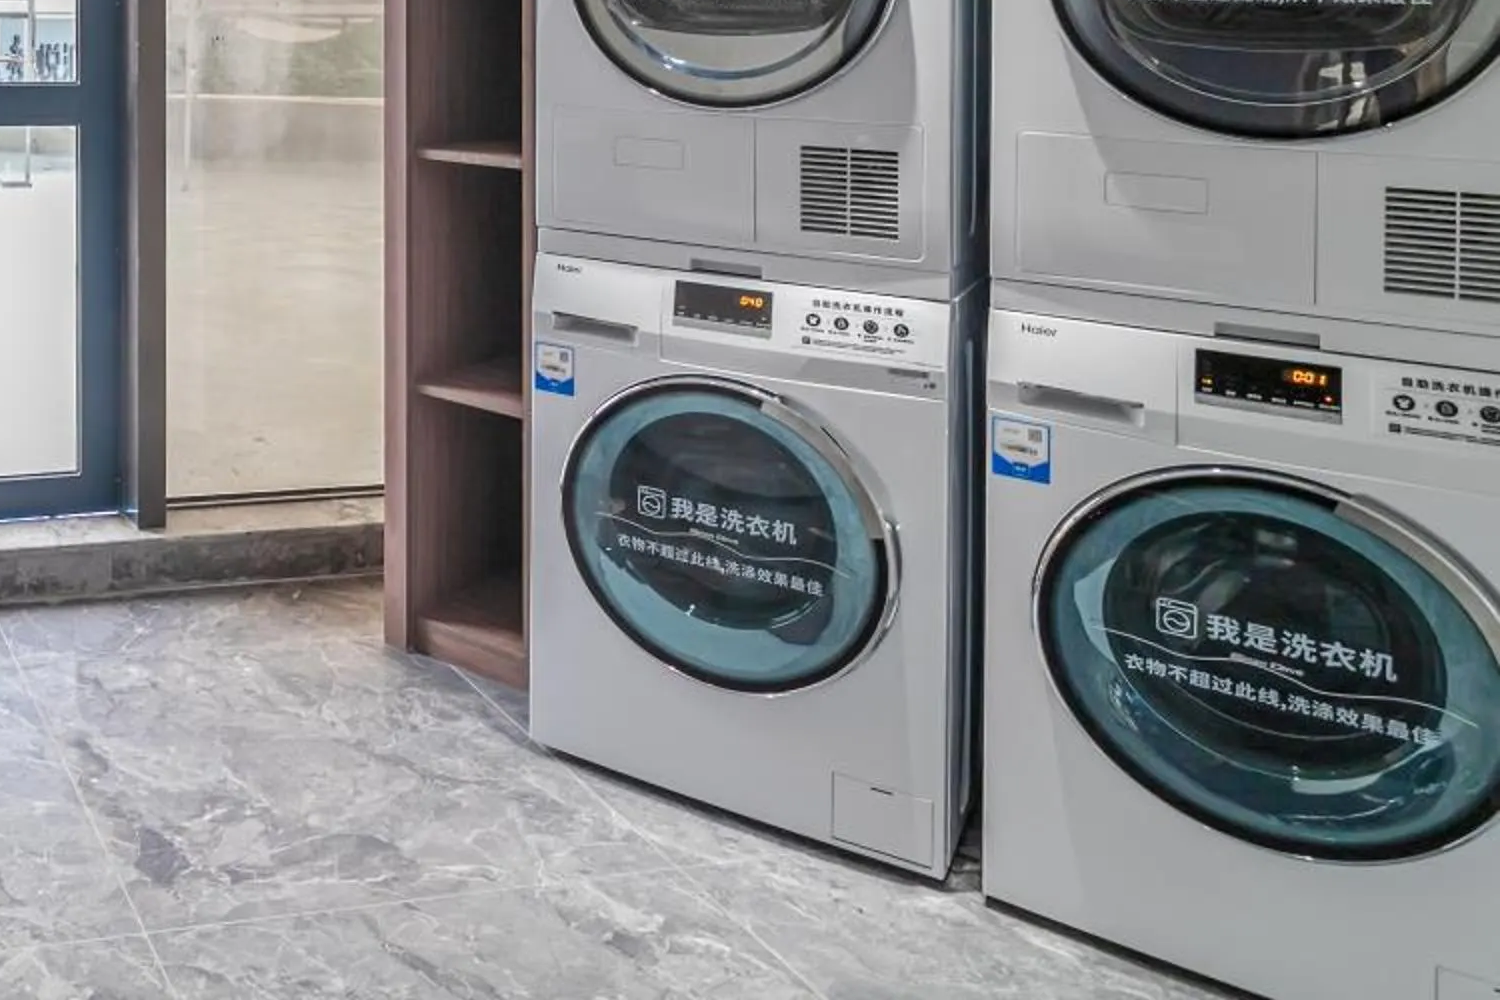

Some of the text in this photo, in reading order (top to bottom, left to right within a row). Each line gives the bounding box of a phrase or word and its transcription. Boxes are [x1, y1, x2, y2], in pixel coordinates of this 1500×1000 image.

[1021, 322, 1058, 337] Haier
[670, 496, 798, 546] 我是洗衣机
[1205, 613, 1398, 683] 我是洗衣机
